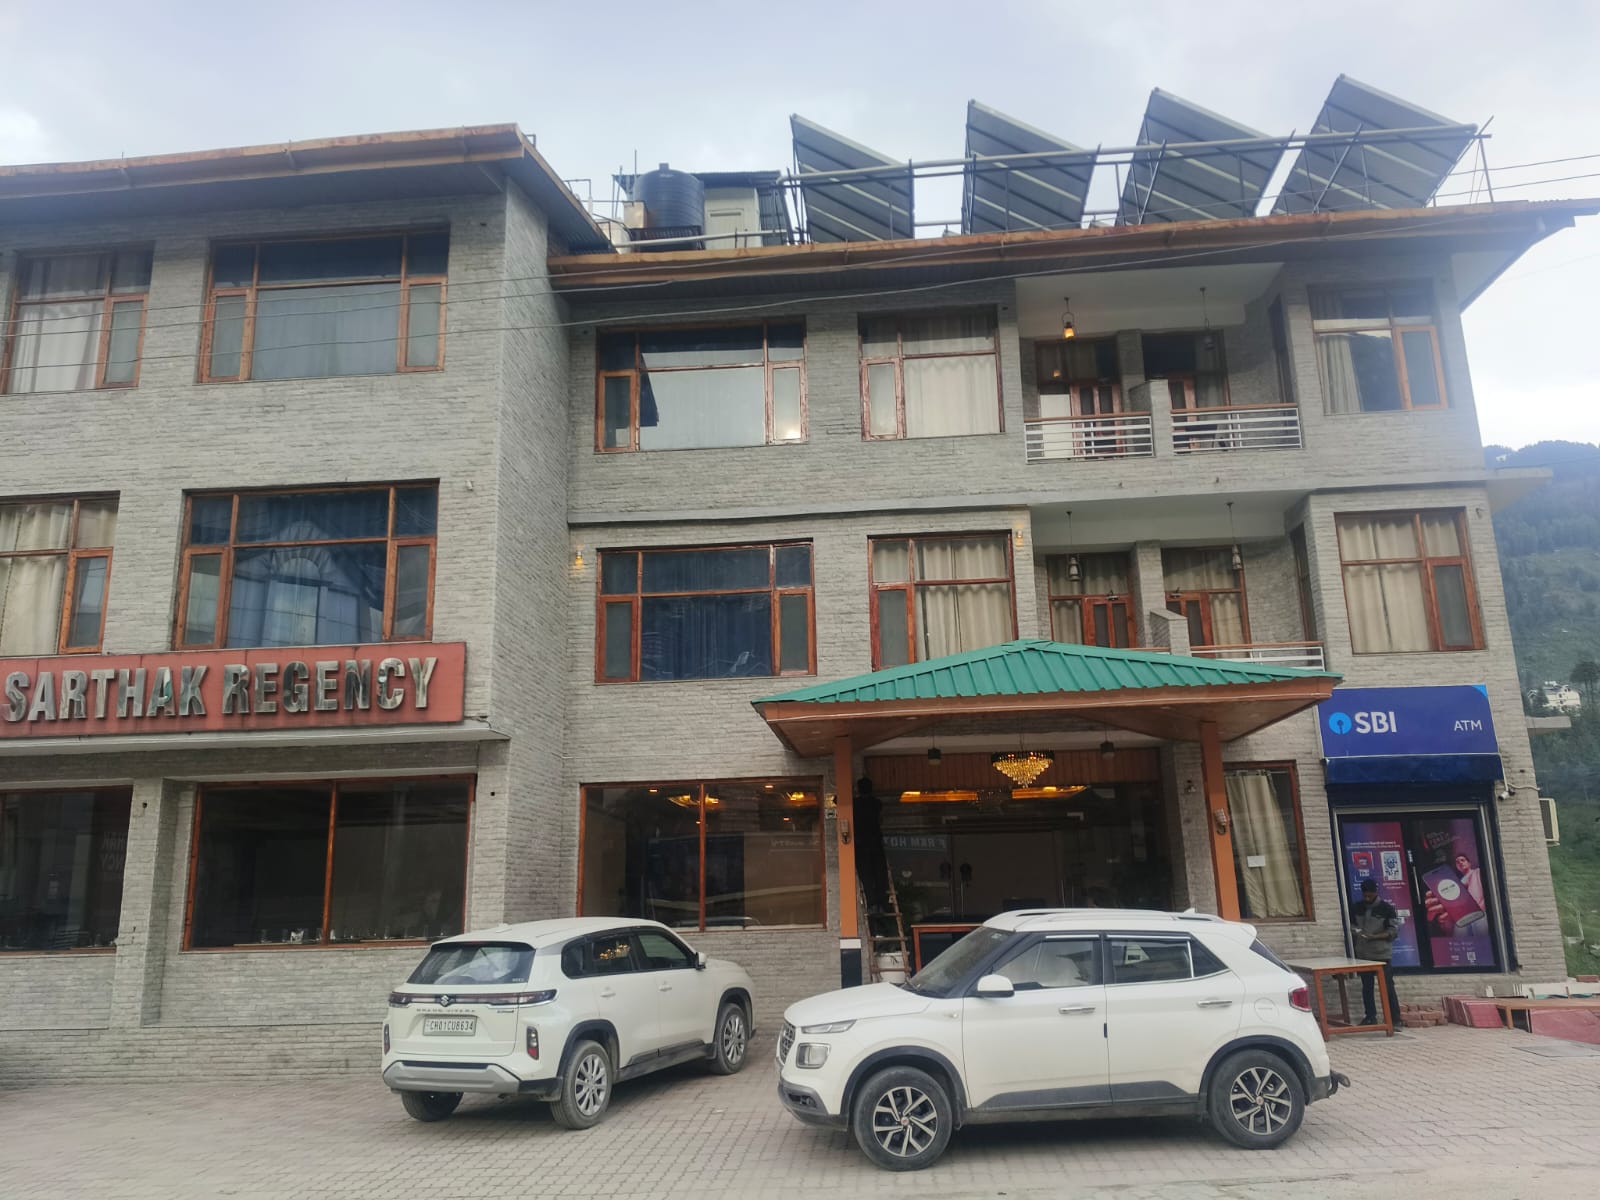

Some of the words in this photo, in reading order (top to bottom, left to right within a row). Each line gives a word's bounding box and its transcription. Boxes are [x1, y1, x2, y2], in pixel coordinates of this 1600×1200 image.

[3, 665, 207, 722] SARTHAK
[222, 656, 437, 715] REGENCY
[1354, 711, 1397, 734] SBI
[1454, 719, 1483, 732] ATM
